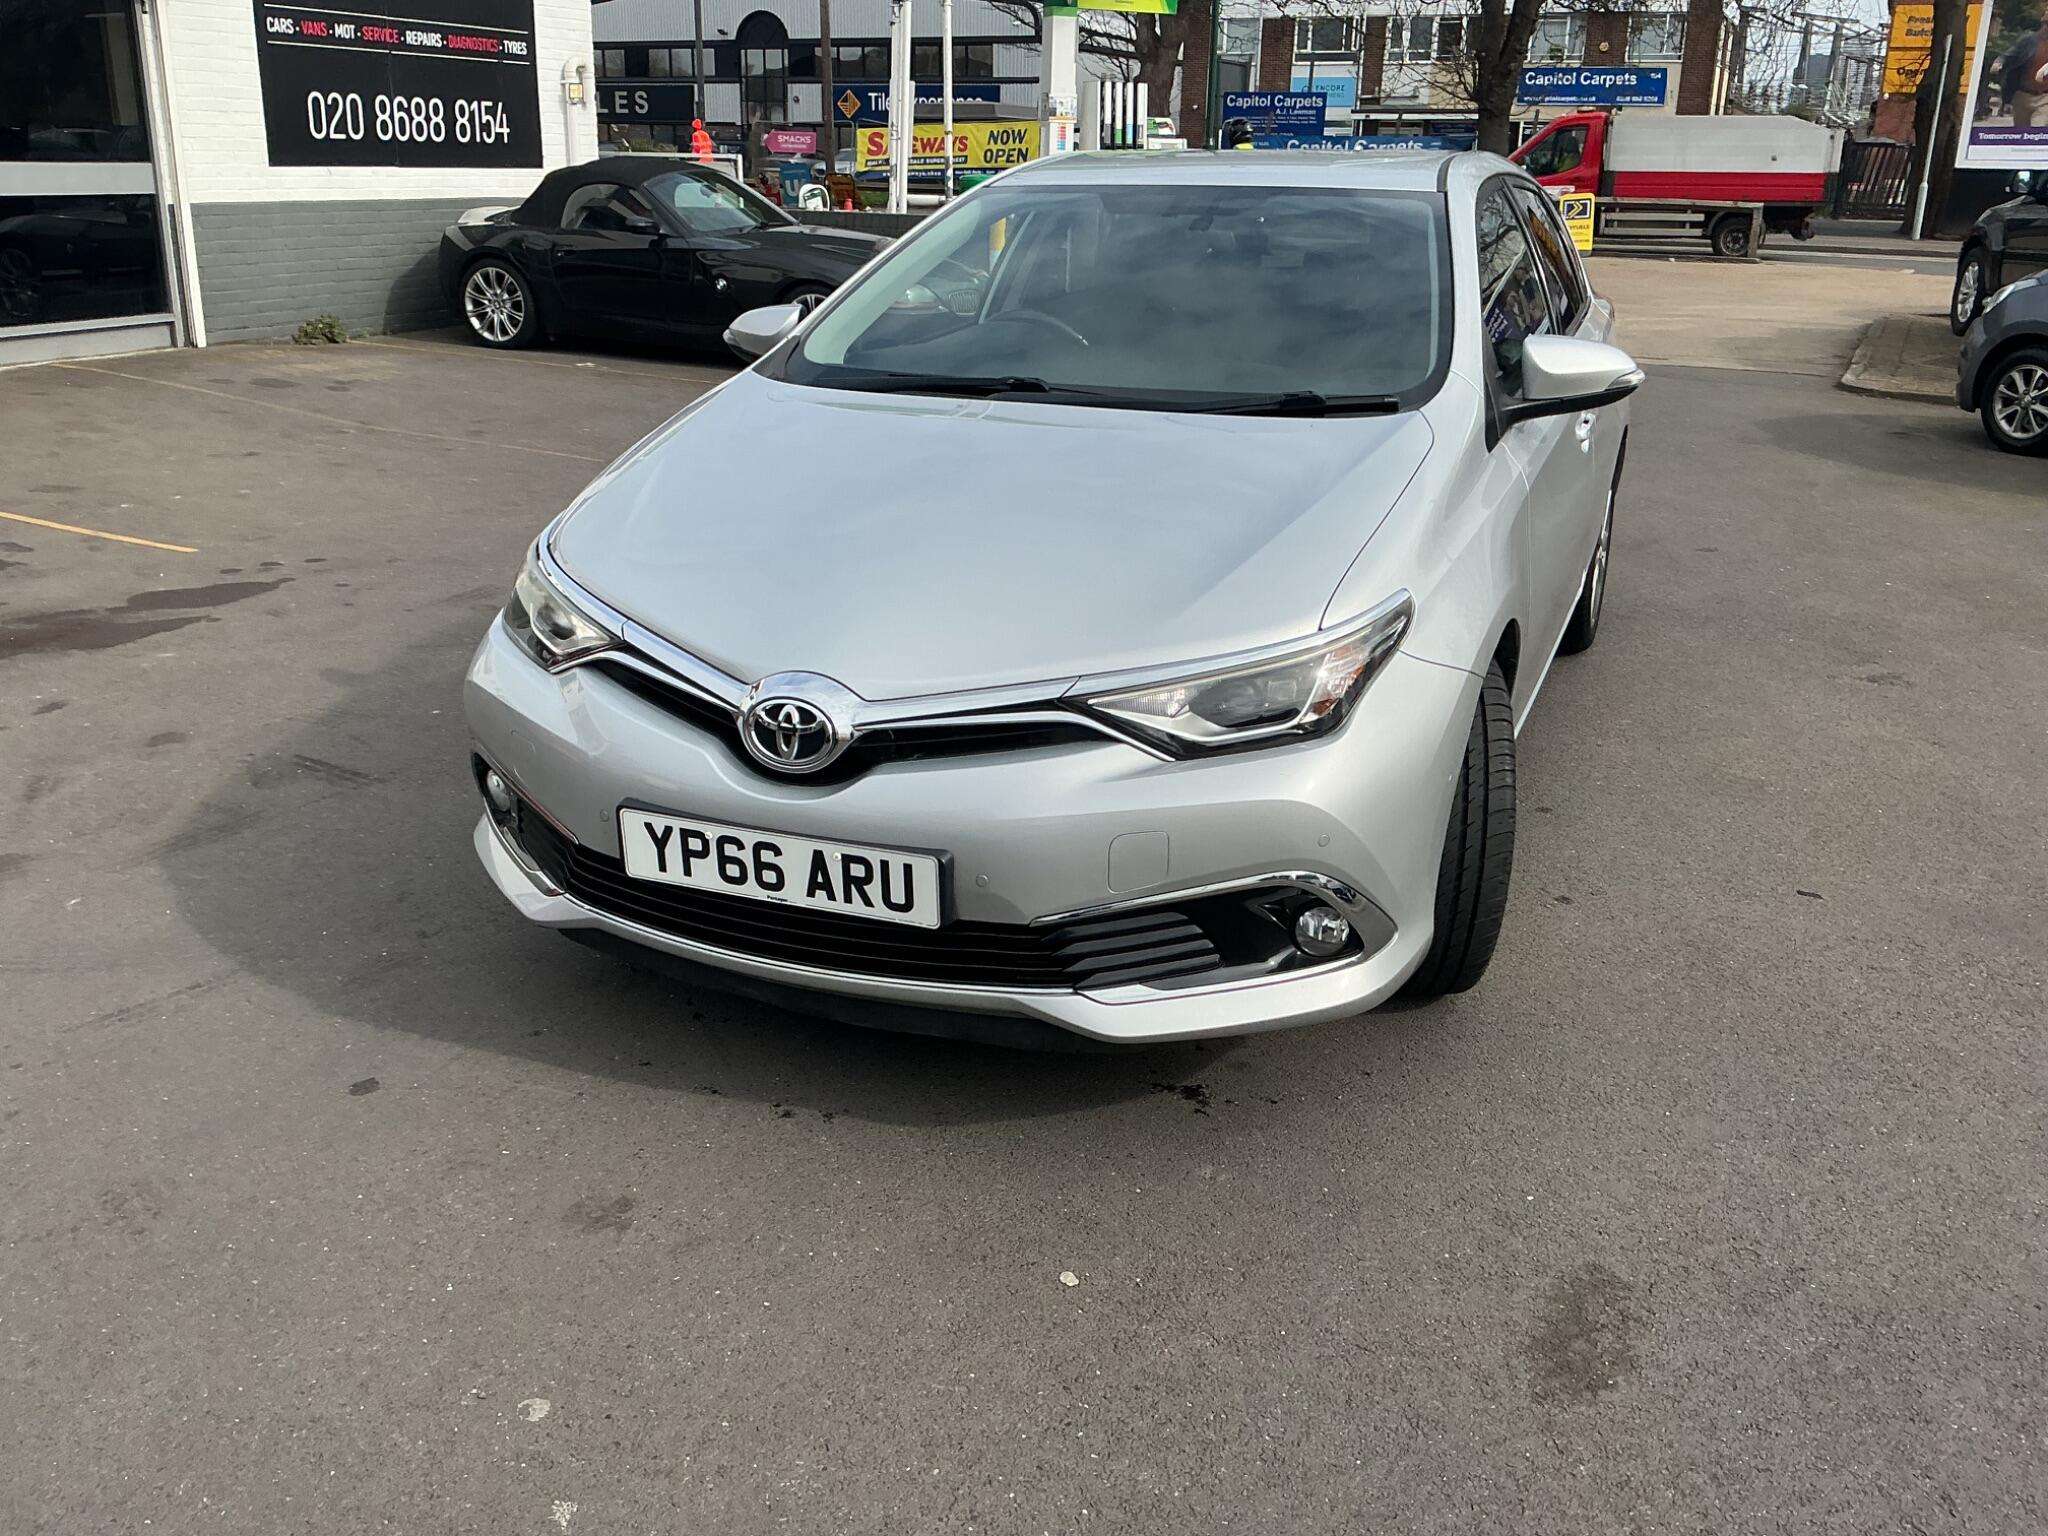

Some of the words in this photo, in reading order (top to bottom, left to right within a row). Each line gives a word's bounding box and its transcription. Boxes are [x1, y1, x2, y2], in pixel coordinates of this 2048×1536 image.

[266, 17, 294, 34] CARS
[301, 20, 328, 36] VANS
[334, 23, 355, 39] MOT
[362, 26, 399, 43] SERVICE
[405, 30, 443, 47] REPAIRS
[448, 34, 499, 52] DIAGNOSTICS
[503, 40, 528, 55] TYRES
[1525, 71, 1576, 87] Capitol
[1580, 71, 1637, 88] Carpets
[1226, 94, 1271, 109] Capitol
[1274, 94, 1324, 109] Carpets
[307, 91, 365, 140] 020
[374, 94, 446, 142] 8688
[454, 98, 510, 144] 8154
[987, 128, 1028, 146] NOW
[1978, 132, 2022, 140] Tomorrow
[983, 147, 1029, 164] OPEN
[643, 821, 785, 893] YP66
[806, 849, 914, 914] ARU
